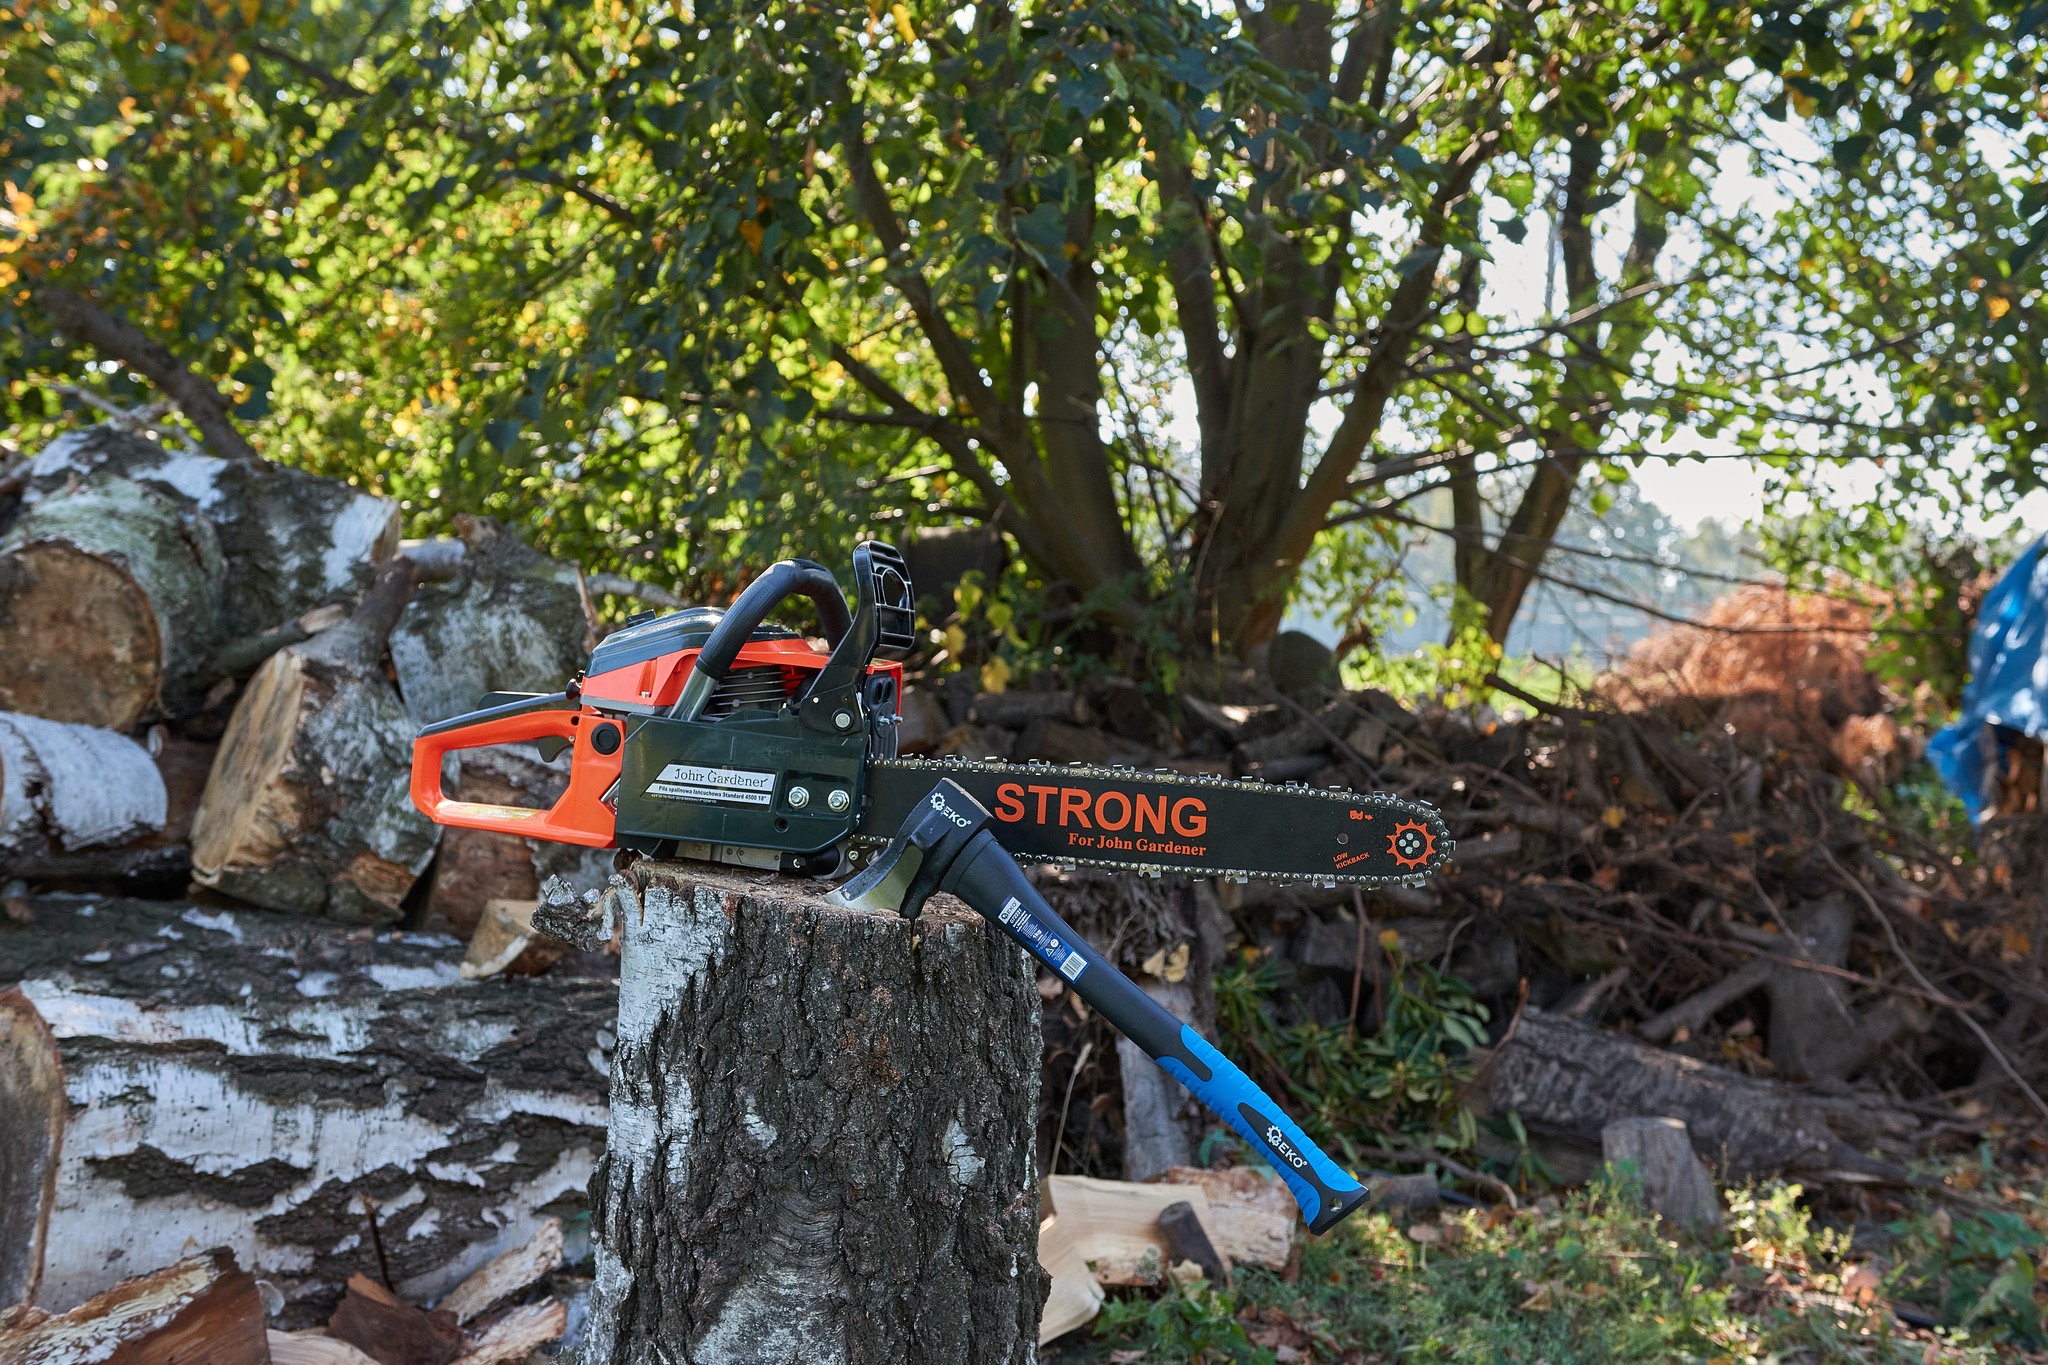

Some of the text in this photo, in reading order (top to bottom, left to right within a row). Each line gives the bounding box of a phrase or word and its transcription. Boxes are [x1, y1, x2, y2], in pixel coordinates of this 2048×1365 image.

[674, 768, 768, 787] John Gardener
[669, 787, 692, 795] spalinowa
[722, 791, 744, 799] Standard
[994, 783, 1207, 837] STRONG
[1068, 833, 1207, 856] For John Gardener
[1333, 852, 1347, 862] LOW
[1336, 852, 1370, 869] KICKBACK
